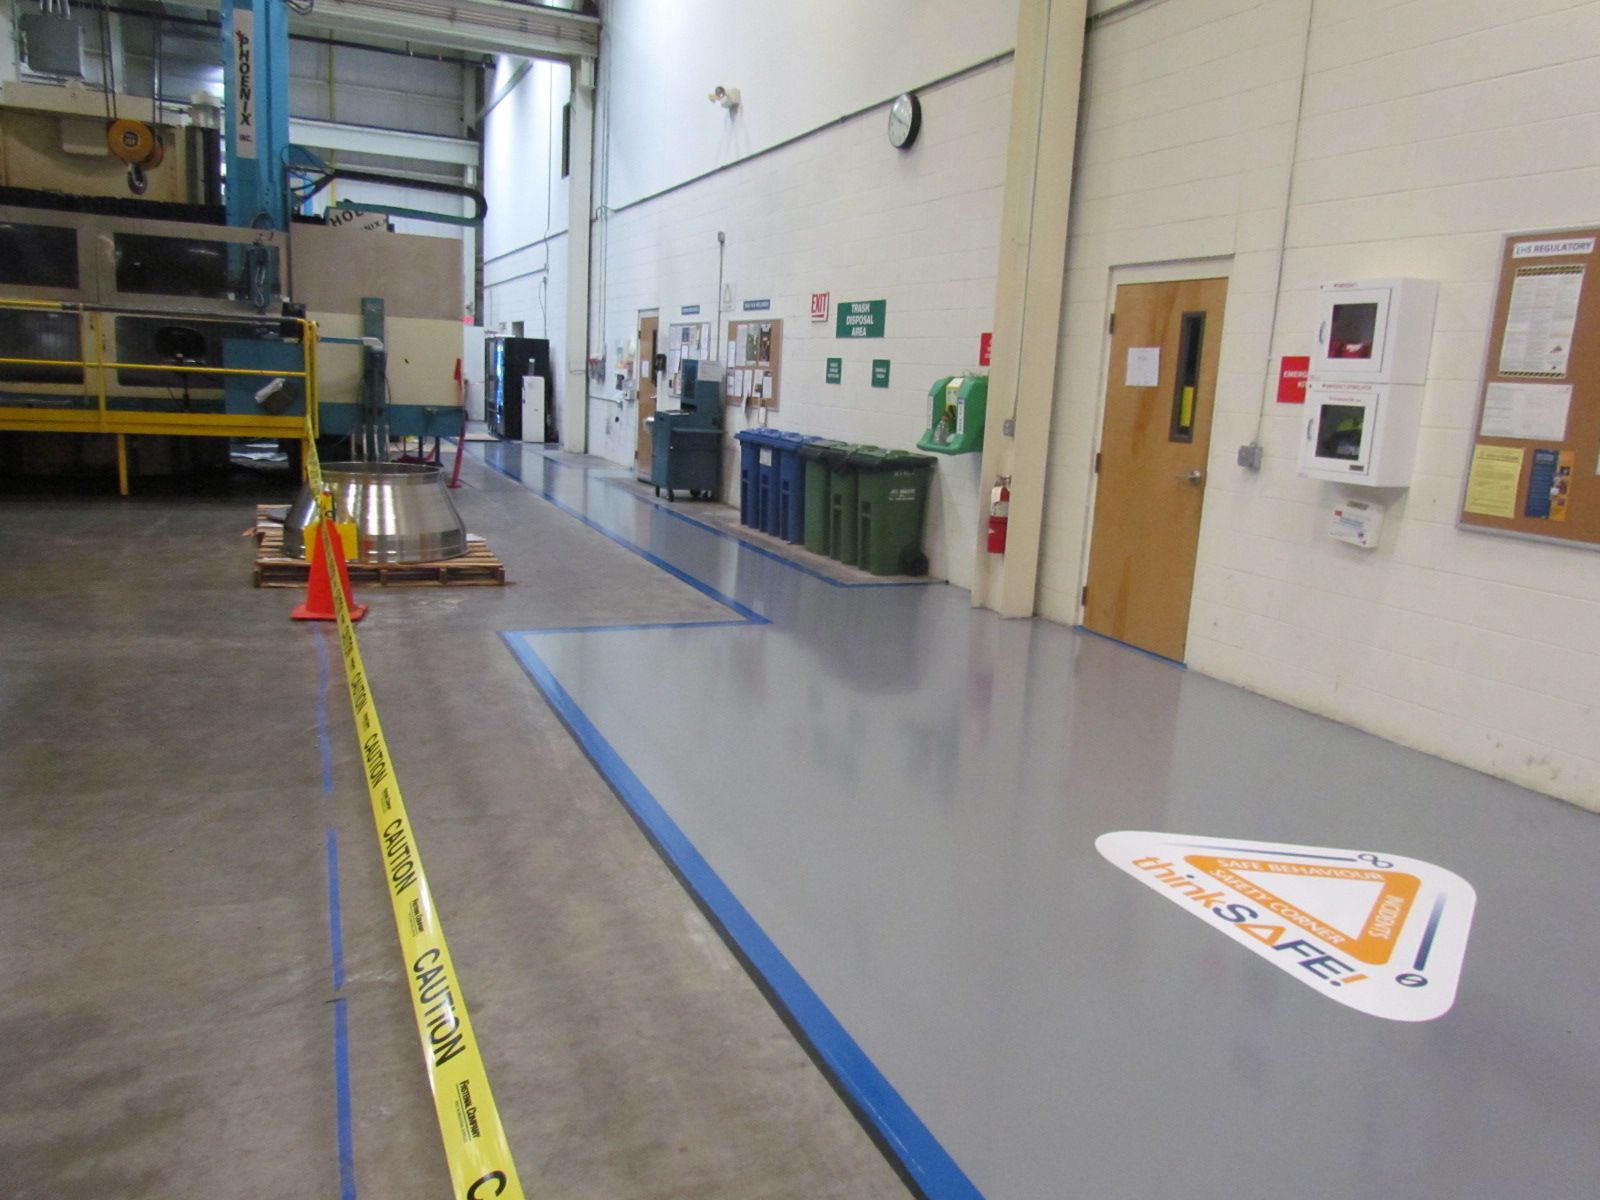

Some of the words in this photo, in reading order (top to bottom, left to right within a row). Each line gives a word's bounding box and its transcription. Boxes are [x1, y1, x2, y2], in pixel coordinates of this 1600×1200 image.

[239, 36, 251, 126] PHOENIX
[1533, 242, 1592, 254] REGULATORY
[811, 292, 828, 314] EXIT
[851, 303, 871, 314] TRASH
[845, 315, 874, 326] DISPOSAL
[851, 327, 867, 337] AREA
[364, 733, 388, 789] CAUTION
[383, 818, 418, 896] CAUTION
[1216, 858, 1263, 872] SAFE
[1267, 863, 1385, 882] BEHAVIOUR
[1208, 869, 1272, 903] SAFETY
[1269, 901, 1347, 945] CORNER
[412, 947, 467, 1068] CAUTION
